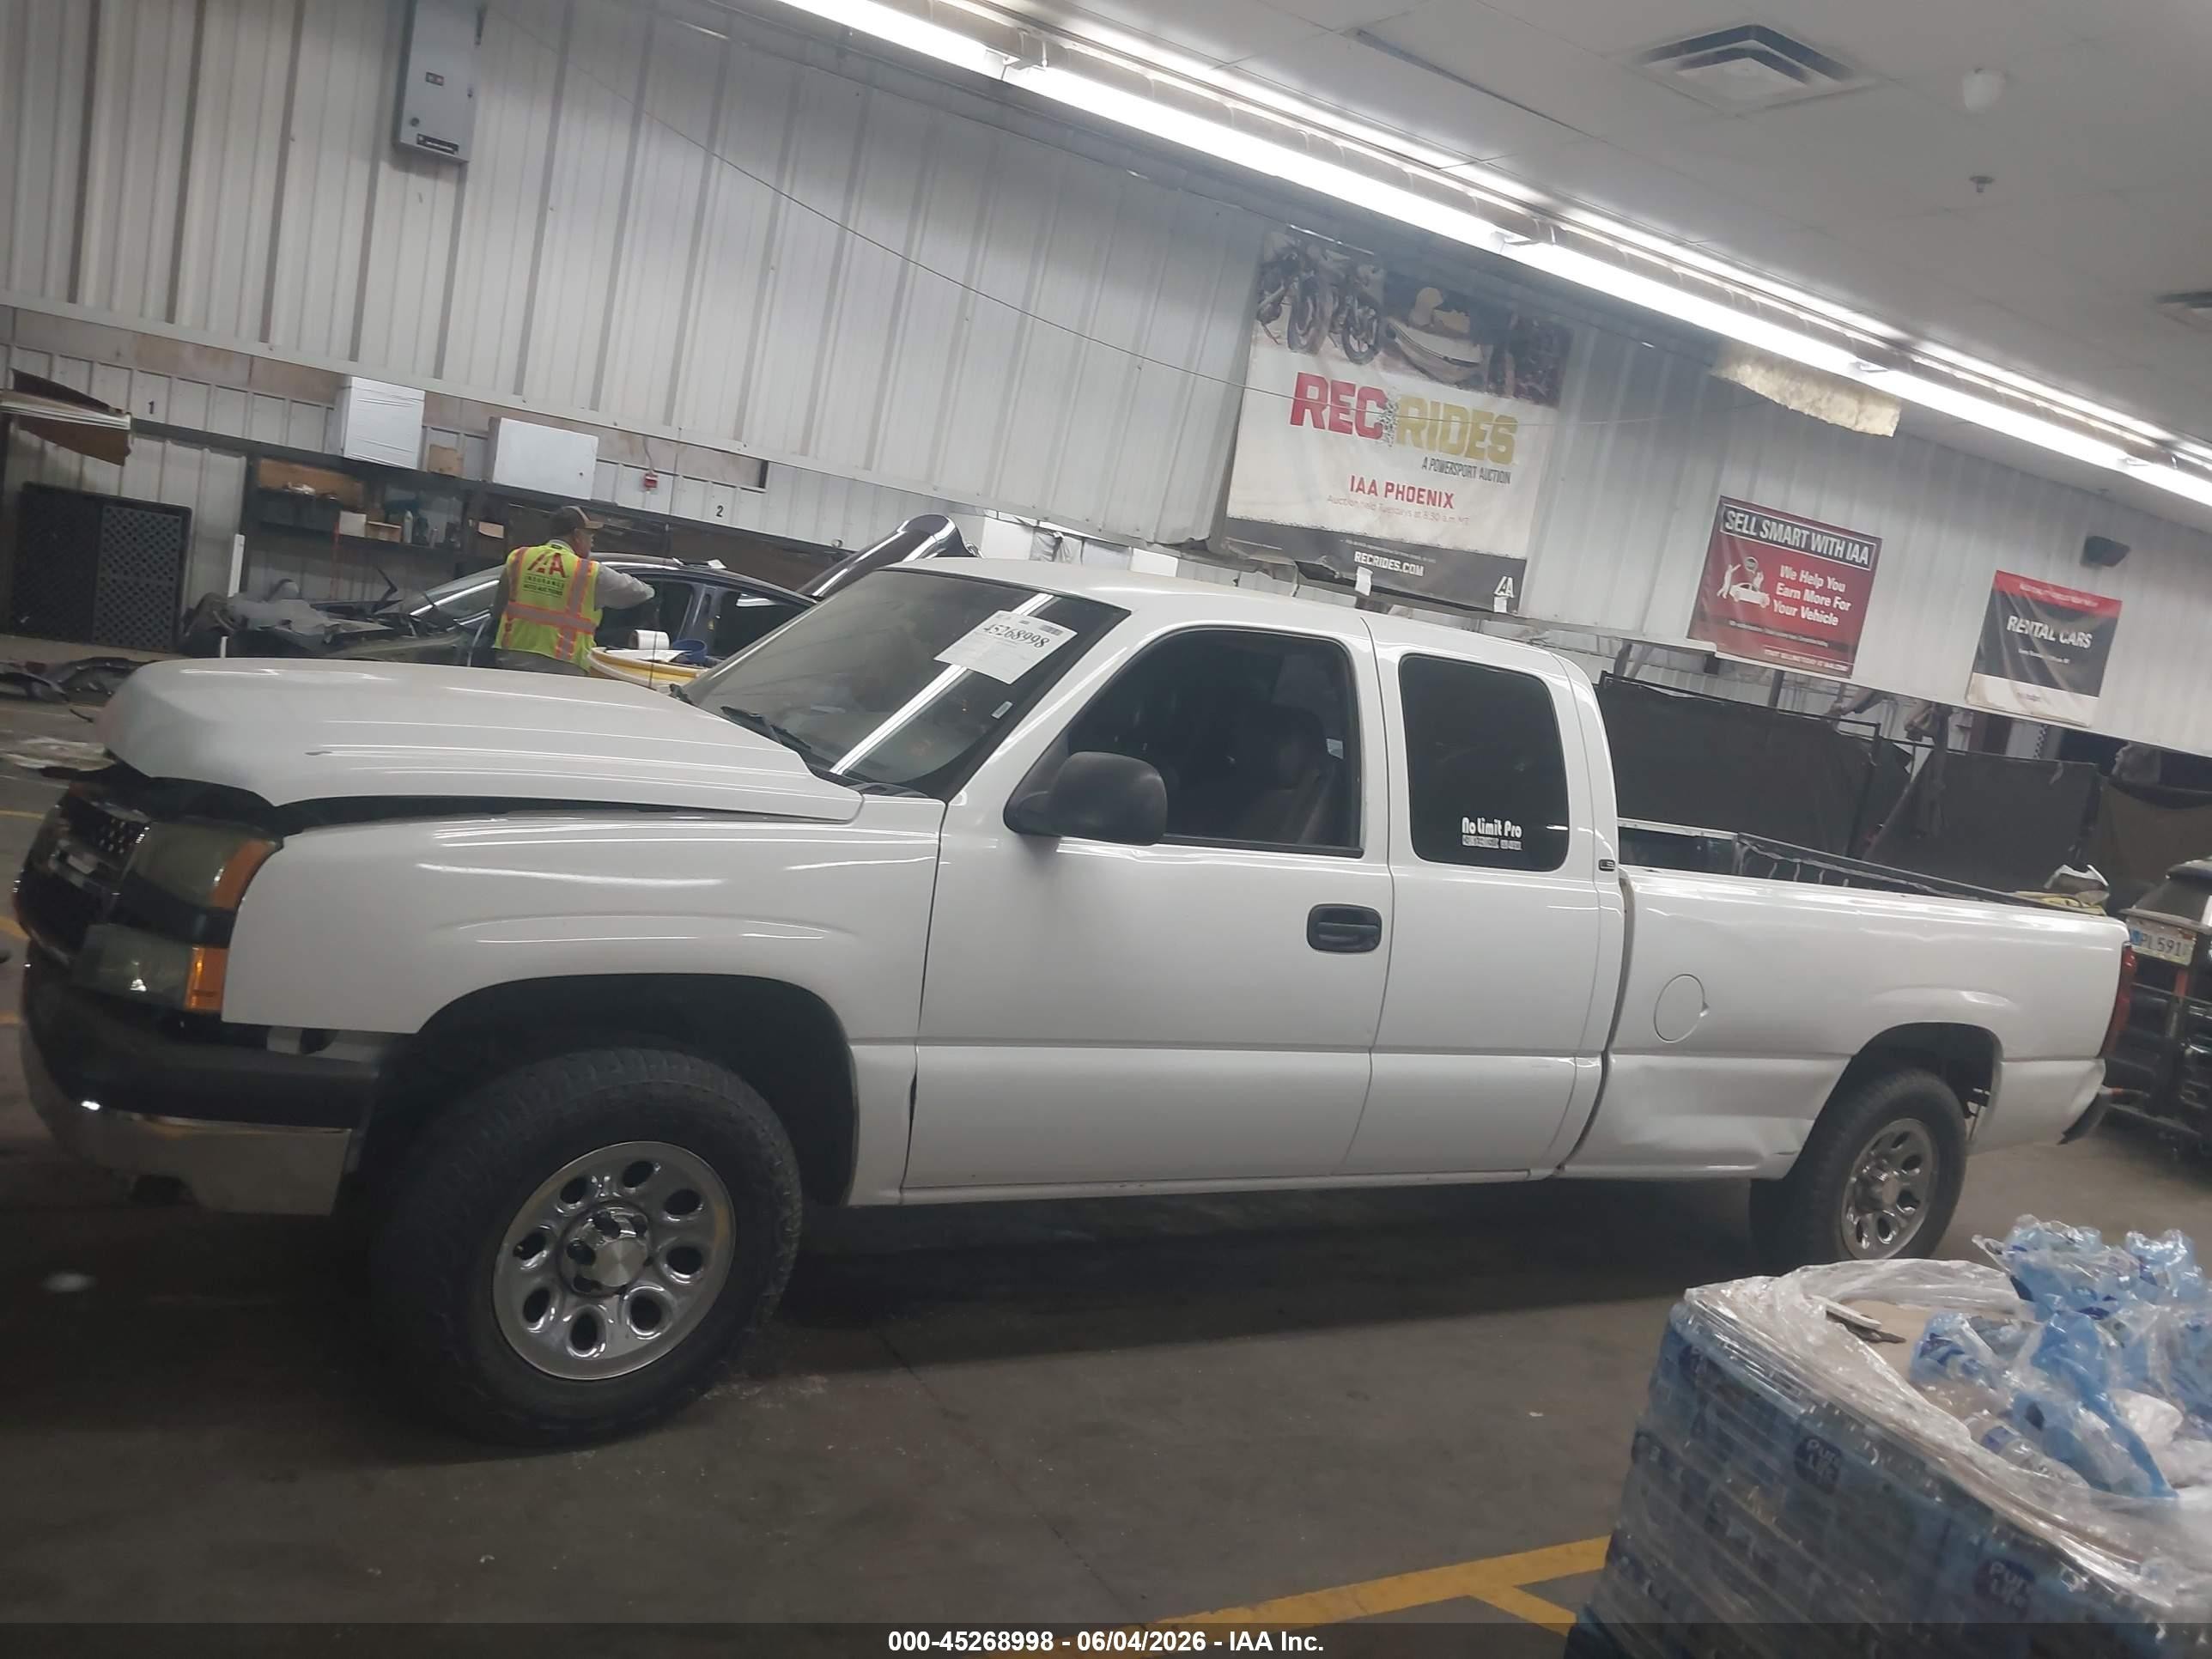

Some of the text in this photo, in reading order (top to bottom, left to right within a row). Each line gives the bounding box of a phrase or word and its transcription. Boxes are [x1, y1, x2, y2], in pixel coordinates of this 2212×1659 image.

[148, 400, 155, 415] 1
[1290, 372, 1519, 465] REC RIDES
[1421, 457, 1512, 484] A POWERSPORT AUCTION
[1349, 474, 1455, 509] IAA PHOENIX
[715, 504, 725, 518] 2
[1724, 510, 1870, 565] SELL SMART WITH IAA
[1353, 550, 1425, 577] RECRIDES.COM
[1779, 564, 1846, 592] We Help You
[1776, 581, 1852, 611] Earn More For
[1772, 599, 1839, 626] Your Vehicle
[2006, 615, 2094, 648] RENTAL CARS
[1462, 817, 1522, 839] No Limit Pro
